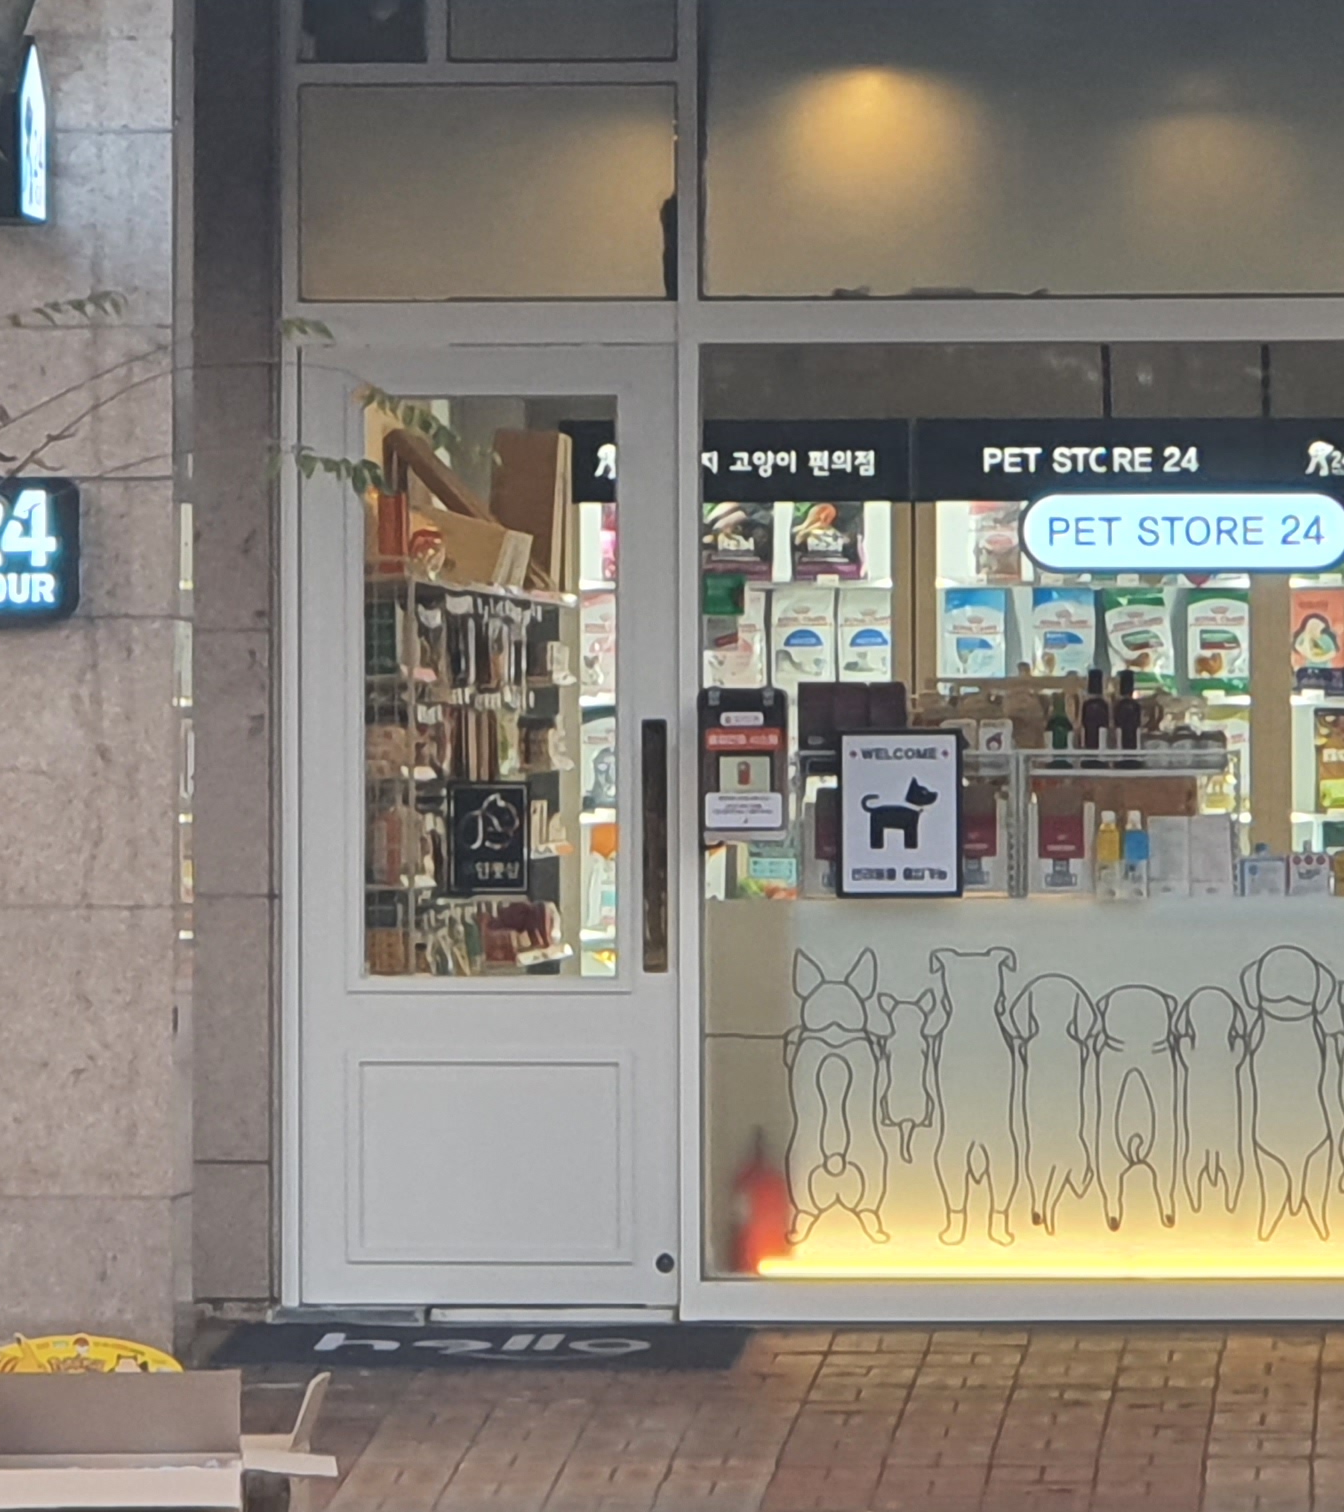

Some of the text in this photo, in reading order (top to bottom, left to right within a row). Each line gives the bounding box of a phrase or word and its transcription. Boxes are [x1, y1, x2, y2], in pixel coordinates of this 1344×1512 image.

[728, 449, 797, 479] 고양이
[807, 449, 876, 477] 편의점
[982, 446, 1042, 474] PET
[1162, 446, 1199, 474] 24
[1047, 515, 1326, 547] PET STORE 24
[860, 747, 938, 761] WELCOME
